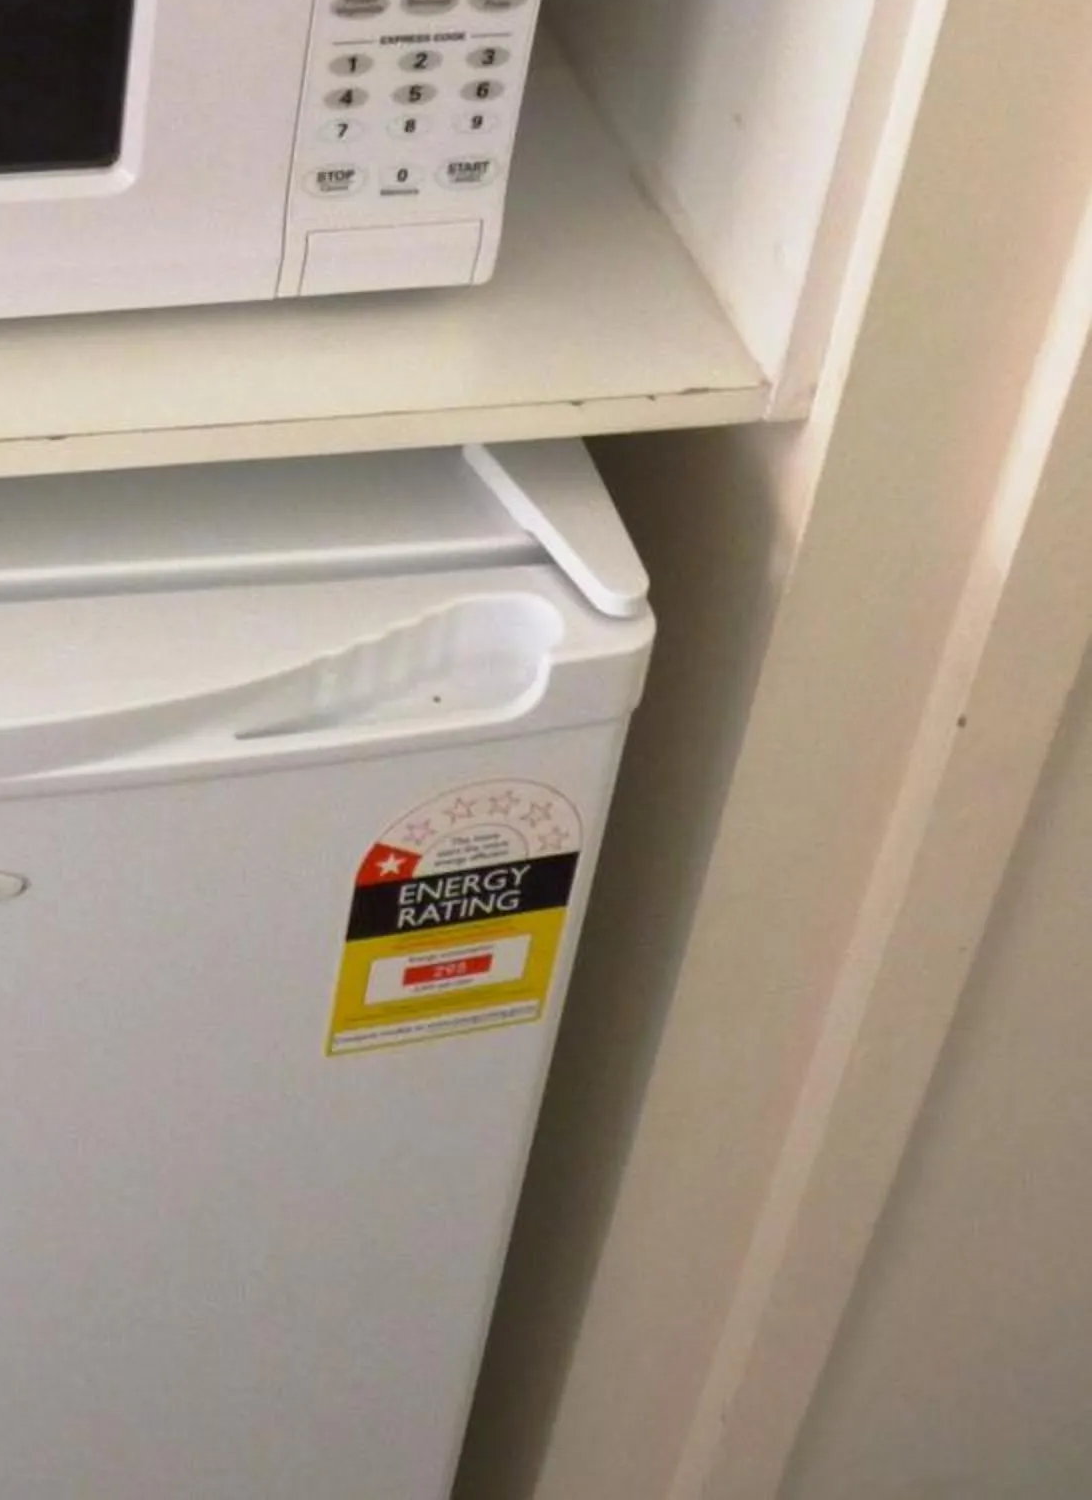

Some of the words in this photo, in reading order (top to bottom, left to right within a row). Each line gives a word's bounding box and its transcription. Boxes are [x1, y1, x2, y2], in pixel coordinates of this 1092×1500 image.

[346, 56, 359, 73] 1
[413, 52, 429, 70] 2
[481, 48, 497, 66] 3
[339, 88, 355, 106] 4
[408, 85, 423, 103] 5
[475, 81, 490, 100] 6
[337, 122, 350, 139] 7
[403, 118, 417, 134] 8
[470, 114, 484, 130] 9
[315, 168, 357, 184] STOP
[396, 167, 409, 183] 0
[446, 160, 491, 176] START
[398, 864, 531, 906] ENERGY
[396, 889, 522, 929] RATING
